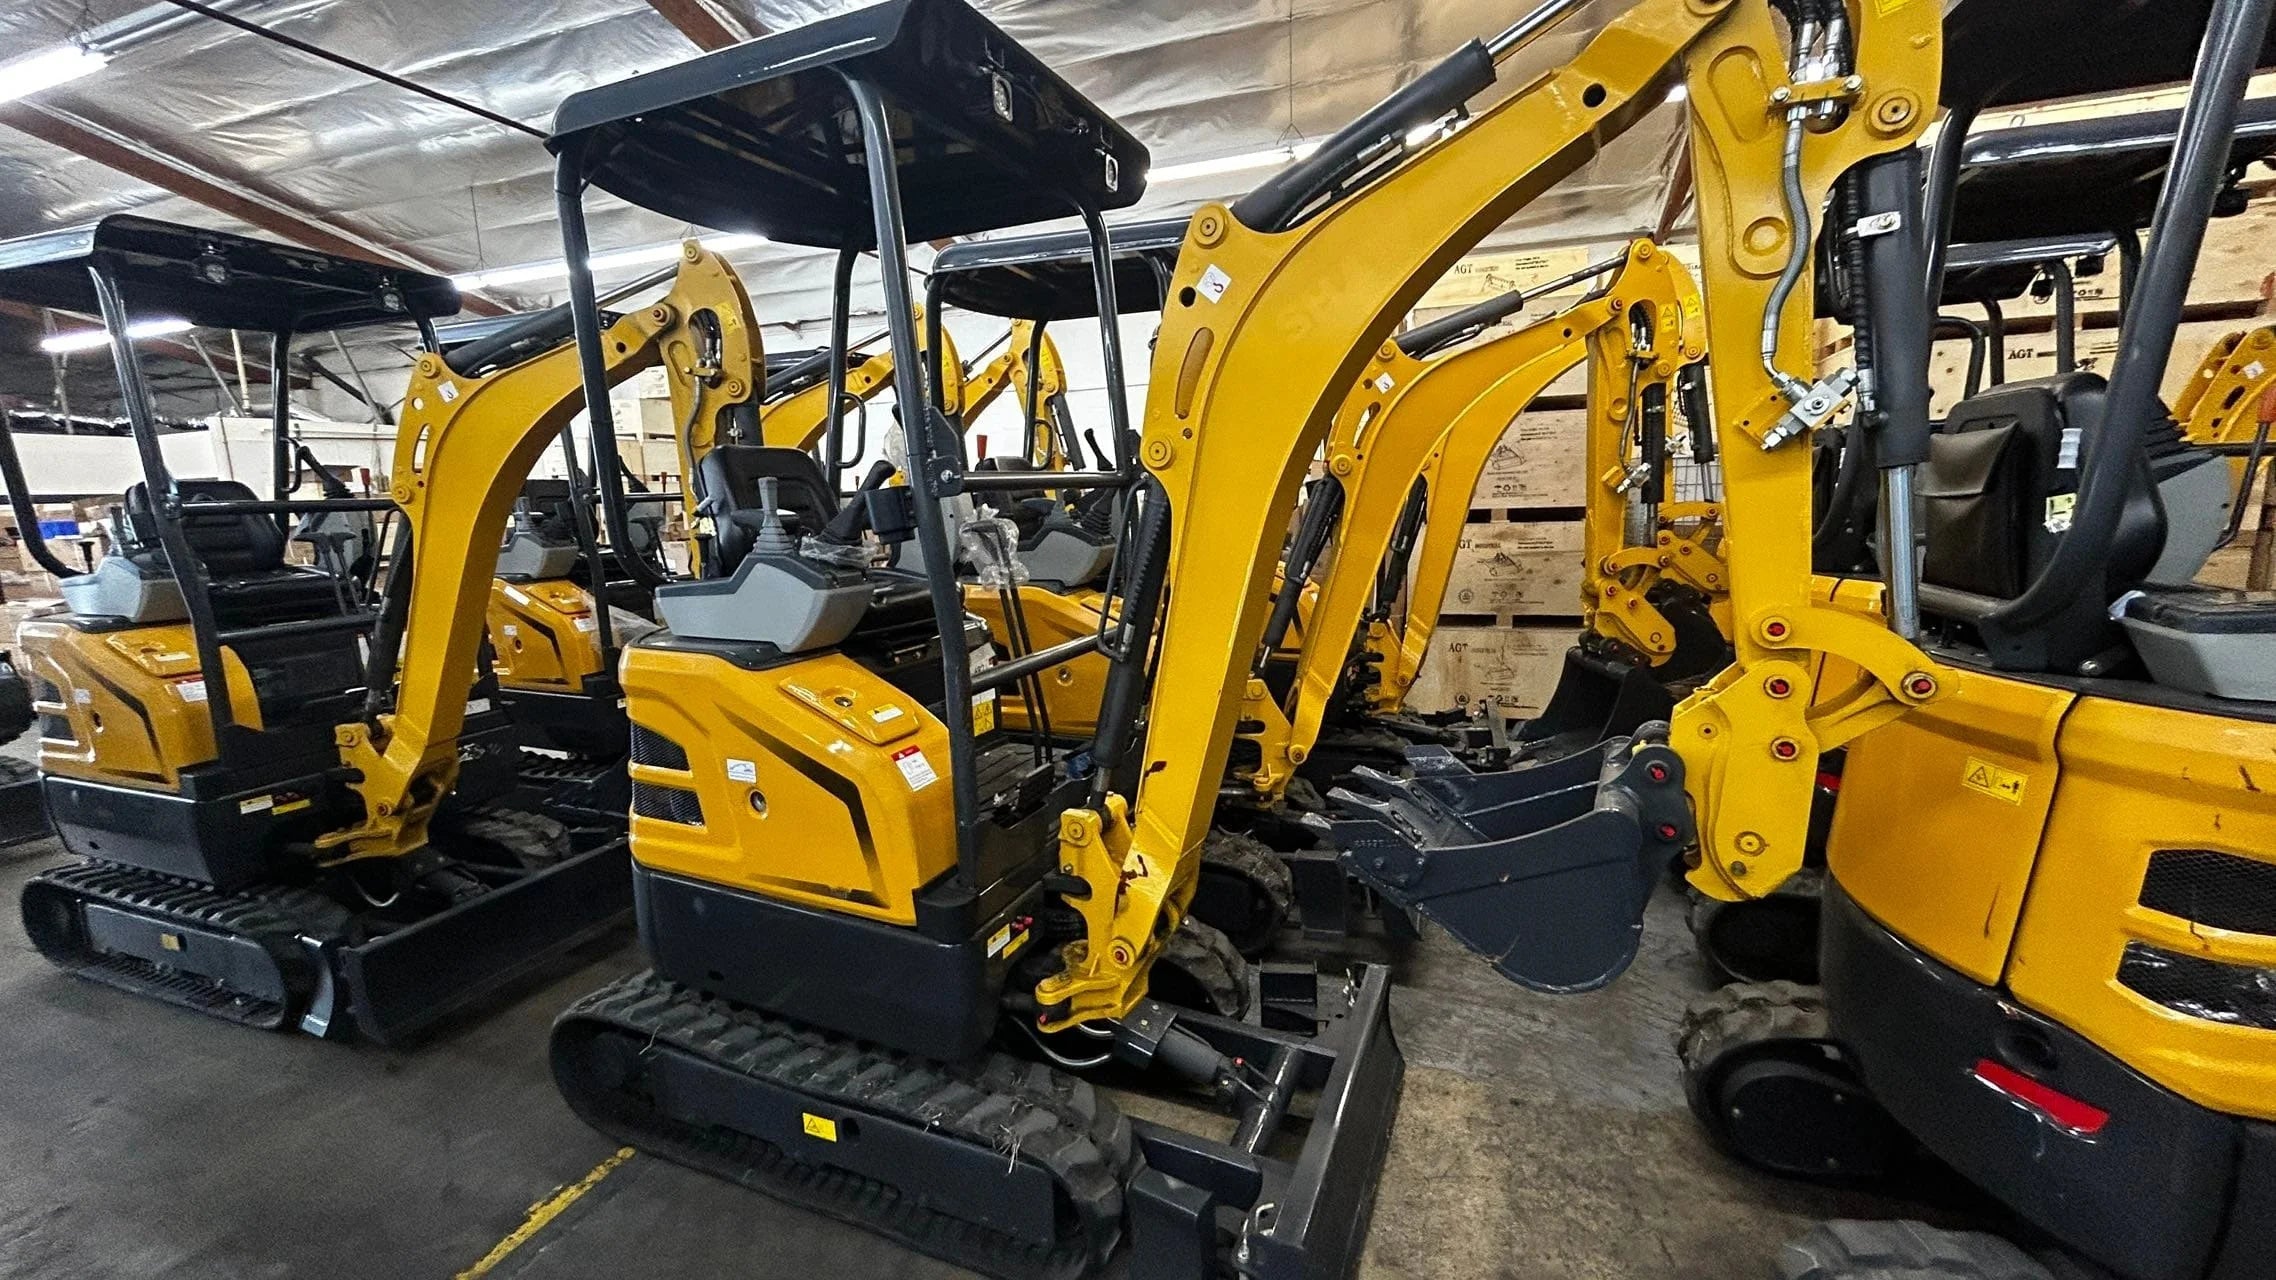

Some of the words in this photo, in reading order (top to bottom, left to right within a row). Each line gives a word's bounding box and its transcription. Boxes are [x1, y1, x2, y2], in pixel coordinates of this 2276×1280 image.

[1454, 264, 1473, 274] AGT
[2008, 349, 2034, 360] AGT
[1458, 539, 1472, 549] GT
[1448, 643, 1468, 653] AGT
